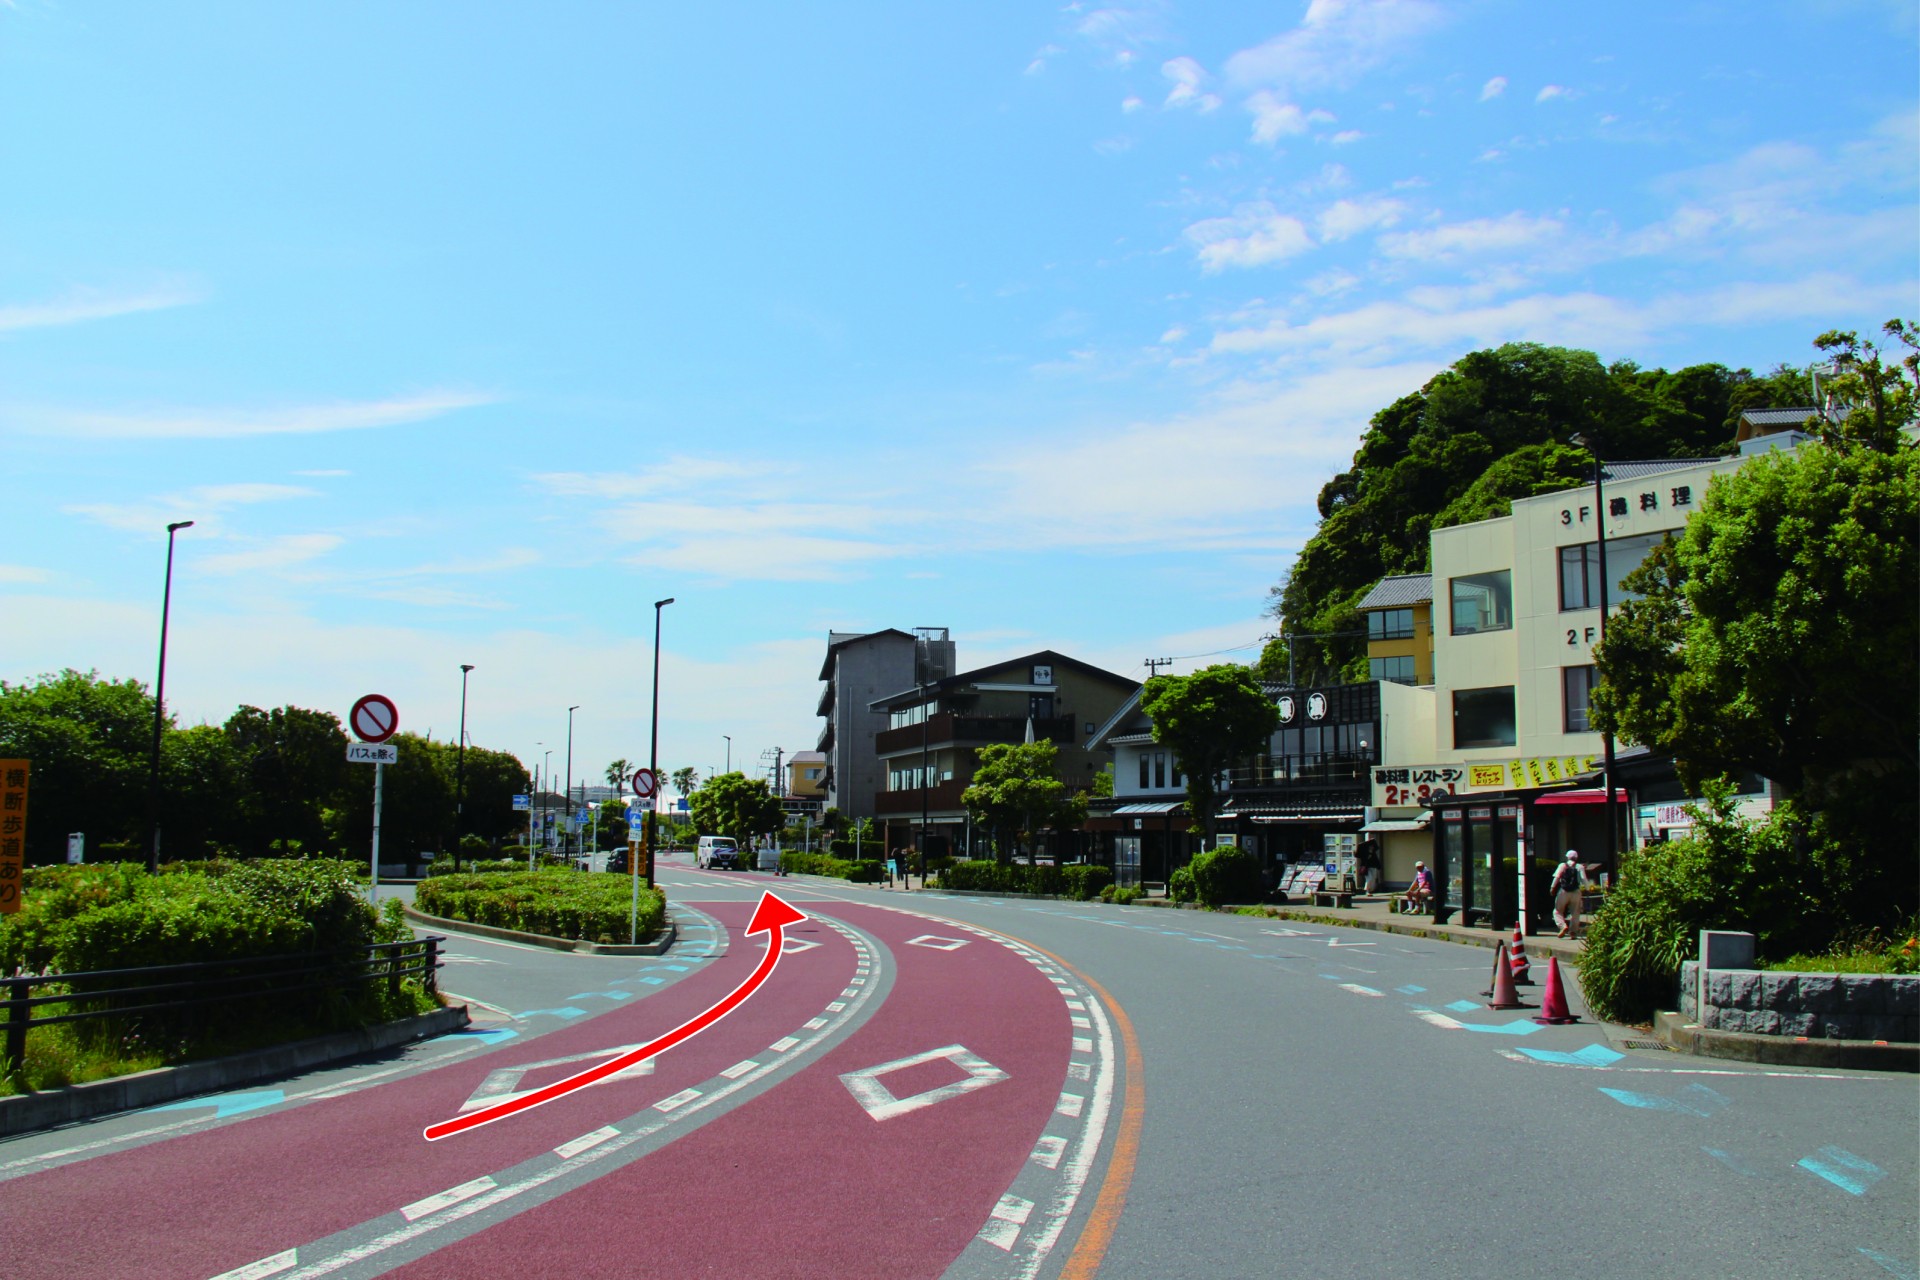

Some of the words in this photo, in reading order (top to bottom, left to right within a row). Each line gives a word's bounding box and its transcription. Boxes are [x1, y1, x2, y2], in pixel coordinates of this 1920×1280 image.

[1609, 485, 1692, 517] 磯料理
[350, 748, 394, 760] バスを除く
[1375, 769, 1409, 784] 磯料理
[1412, 769, 1463, 784] レストラン
[0, 768, 25, 904] 横断歩道あり
